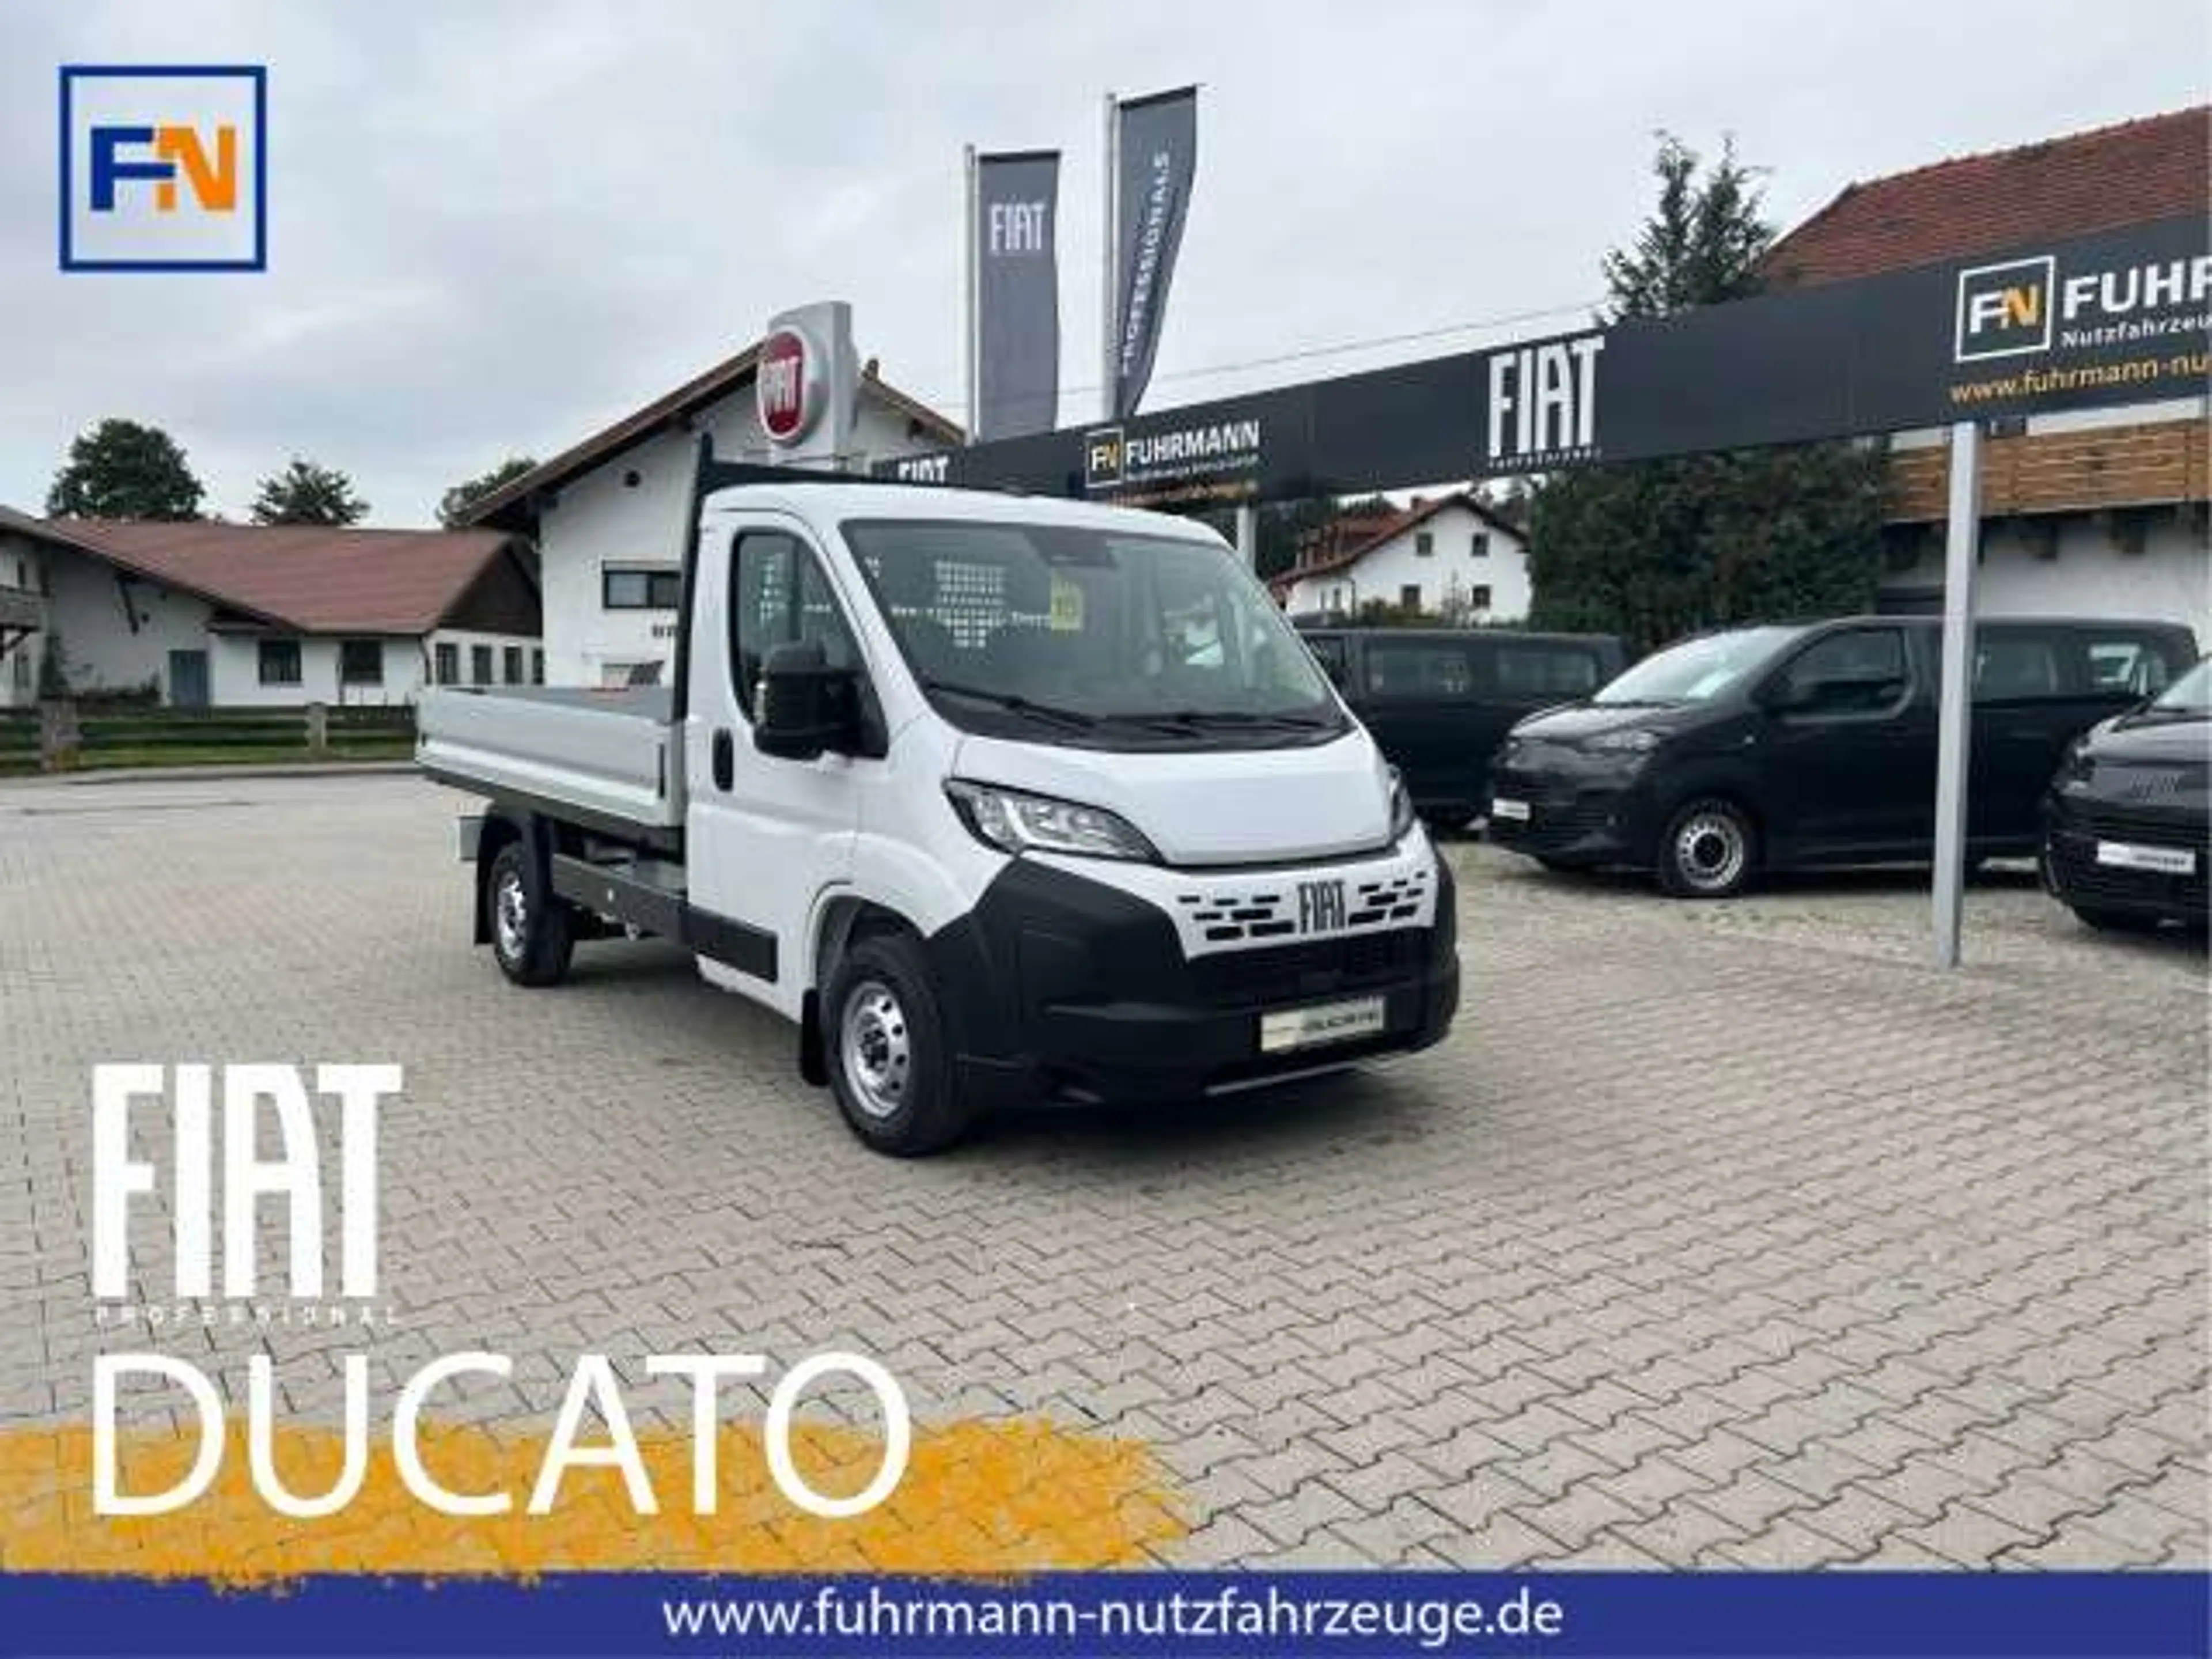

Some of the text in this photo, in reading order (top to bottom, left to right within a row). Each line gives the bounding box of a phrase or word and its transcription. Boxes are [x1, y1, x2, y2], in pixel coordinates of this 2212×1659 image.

[991, 202, 1045, 251] FIAT
[1969, 285, 2038, 333] FN
[1488, 335, 1605, 457] FIAT
[1126, 419, 1260, 465] FUHRMANN
[1297, 878, 1346, 933] FIAT
